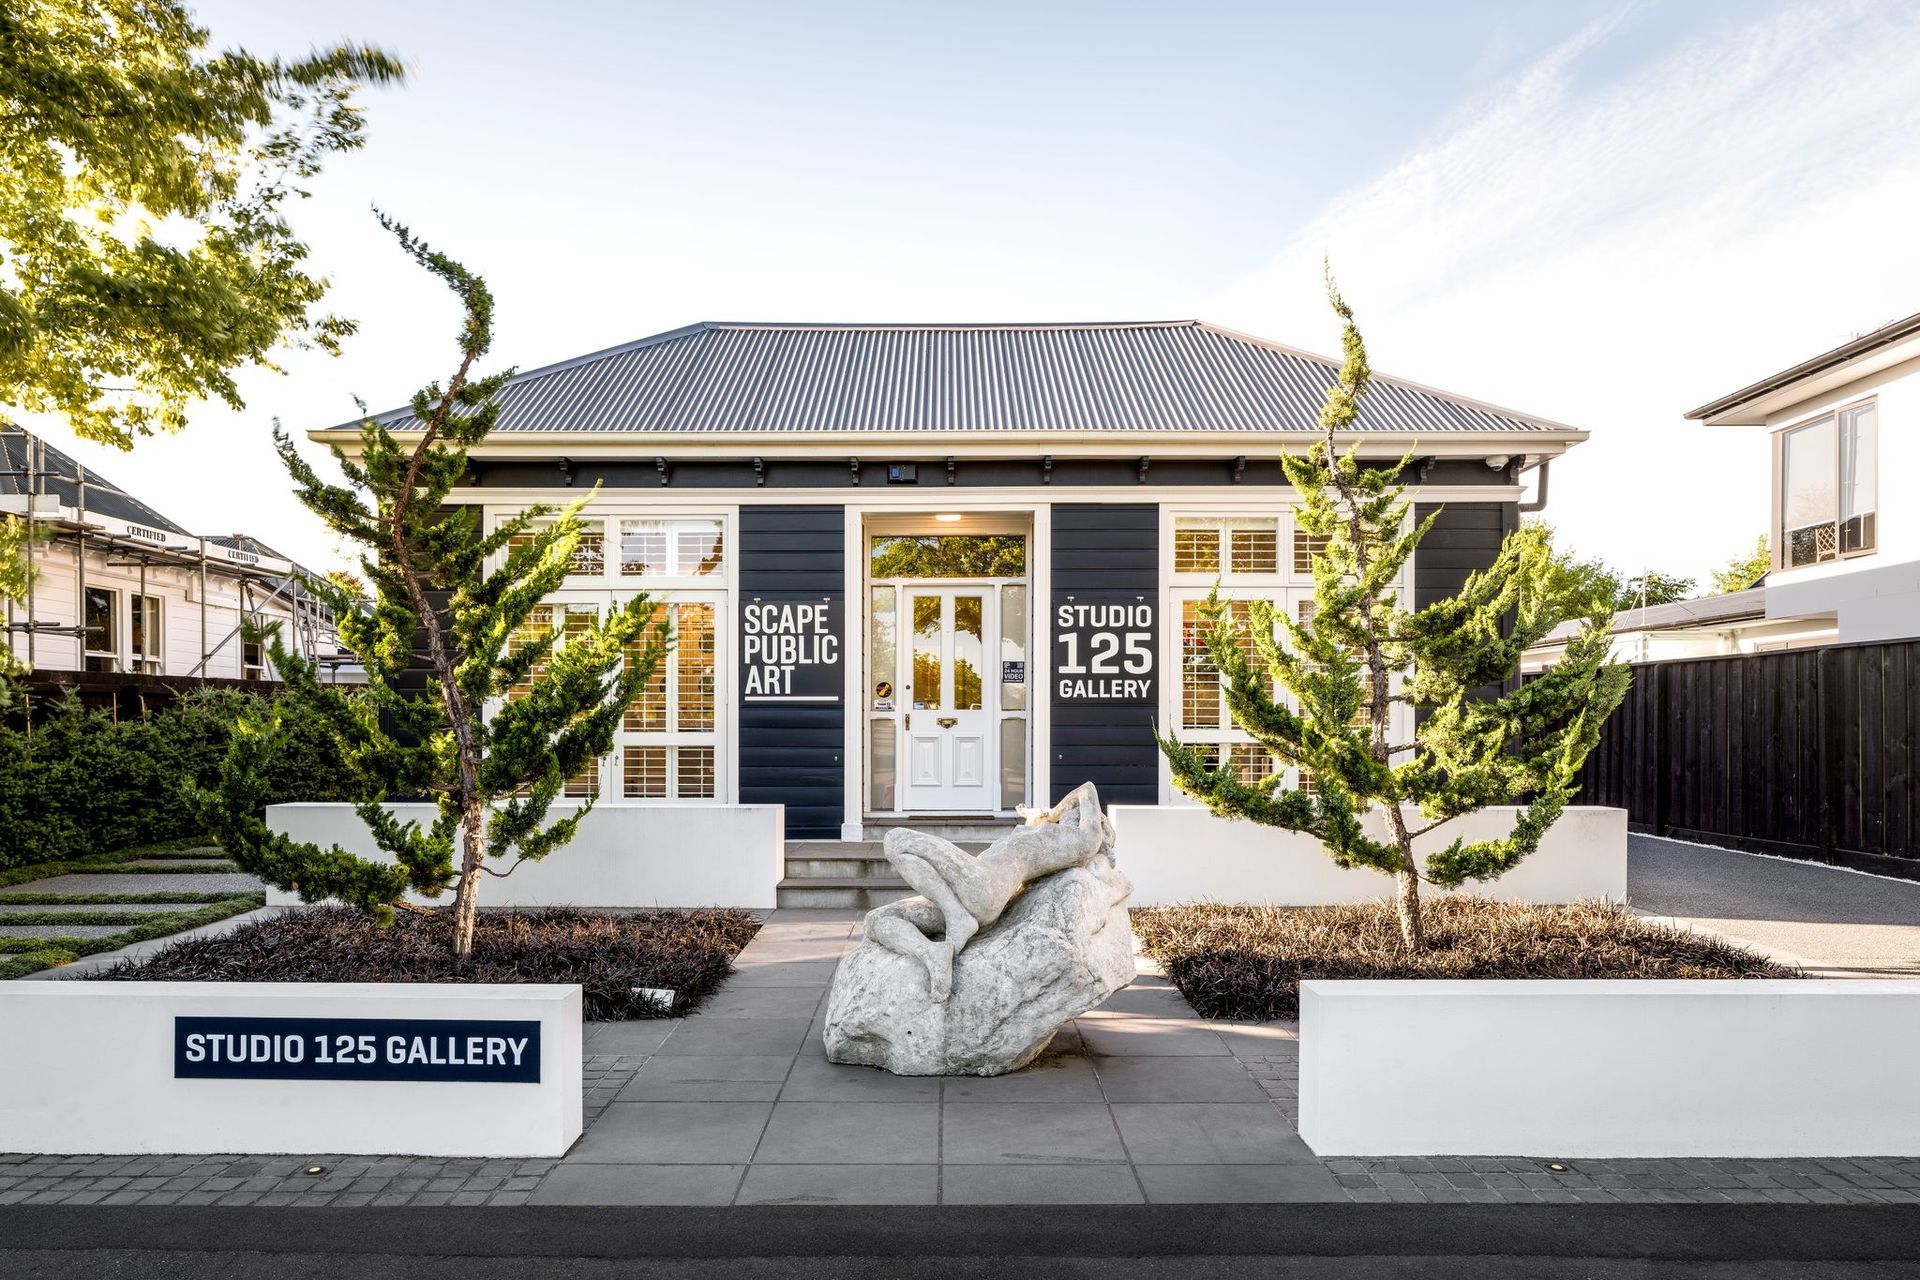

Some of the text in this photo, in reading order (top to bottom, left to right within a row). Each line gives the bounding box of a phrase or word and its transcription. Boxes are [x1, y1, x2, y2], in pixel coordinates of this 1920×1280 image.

[126, 525, 166, 542] CERTIFIED
[227, 550, 260, 563] CERTIFIED
[744, 604, 829, 634] SCAPE
[1058, 605, 1152, 627] STUDIO
[744, 635, 838, 664] PUBLIC
[1058, 632, 1153, 675] 125
[744, 665, 795, 694] ART
[1059, 679, 1152, 698] GALLERY
[186, 1033, 528, 1066] STUDIO 125 GALLERY
